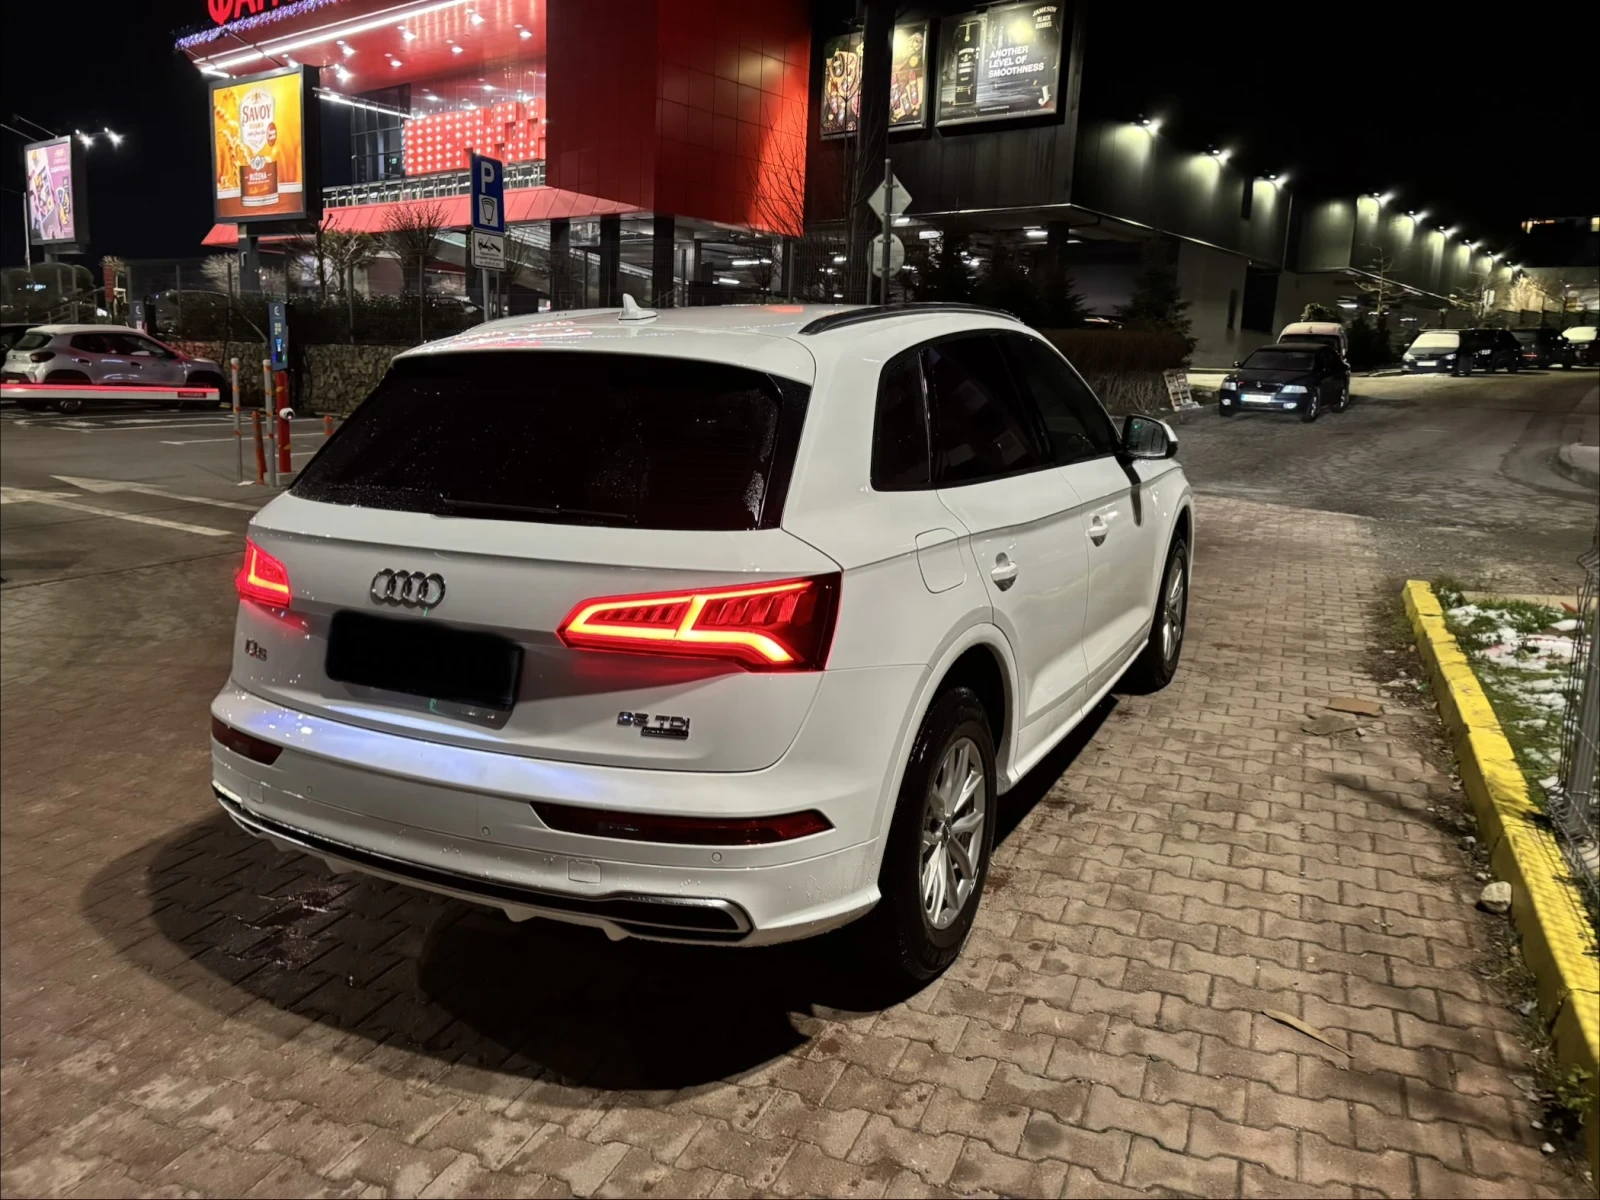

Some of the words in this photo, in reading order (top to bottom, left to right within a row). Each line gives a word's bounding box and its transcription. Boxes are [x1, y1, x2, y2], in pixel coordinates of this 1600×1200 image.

[990, 46, 1028, 58] ANOTHER
[989, 58, 1014, 68] LEVEL
[1015, 55, 1028, 65] OF
[988, 62, 1045, 78] SMOOTHNESS
[242, 103, 272, 127] SAVOY
[481, 160, 495, 194] P
[655, 715, 690, 730] TDI
